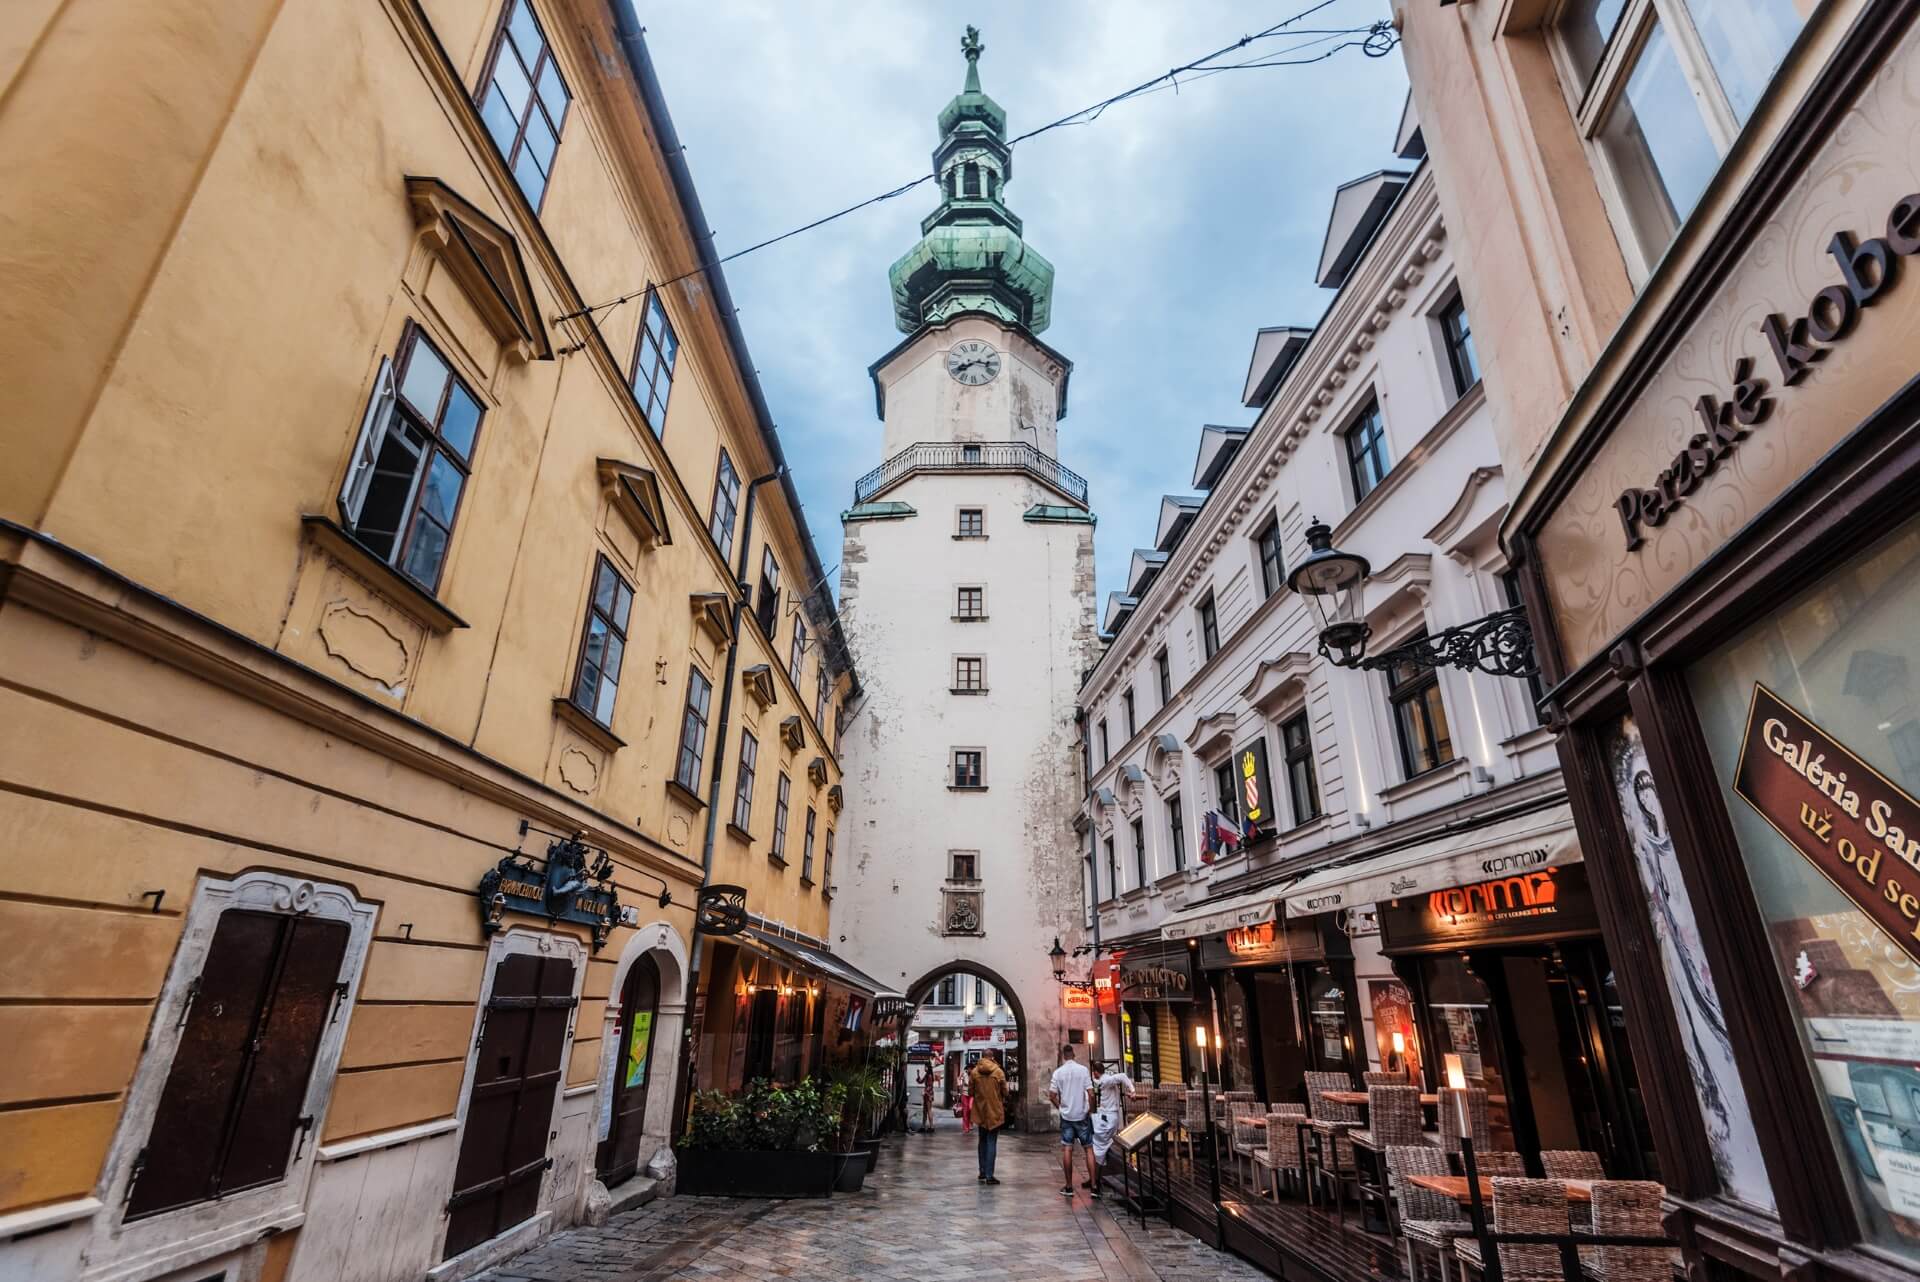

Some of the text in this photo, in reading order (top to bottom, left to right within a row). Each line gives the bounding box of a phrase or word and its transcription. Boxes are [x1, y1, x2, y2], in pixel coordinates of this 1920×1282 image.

[1612, 357, 1775, 552] Perzské
[1762, 718, 1860, 819] Galéria
[1800, 801, 1831, 844] už
[1837, 838, 1882, 886] od
